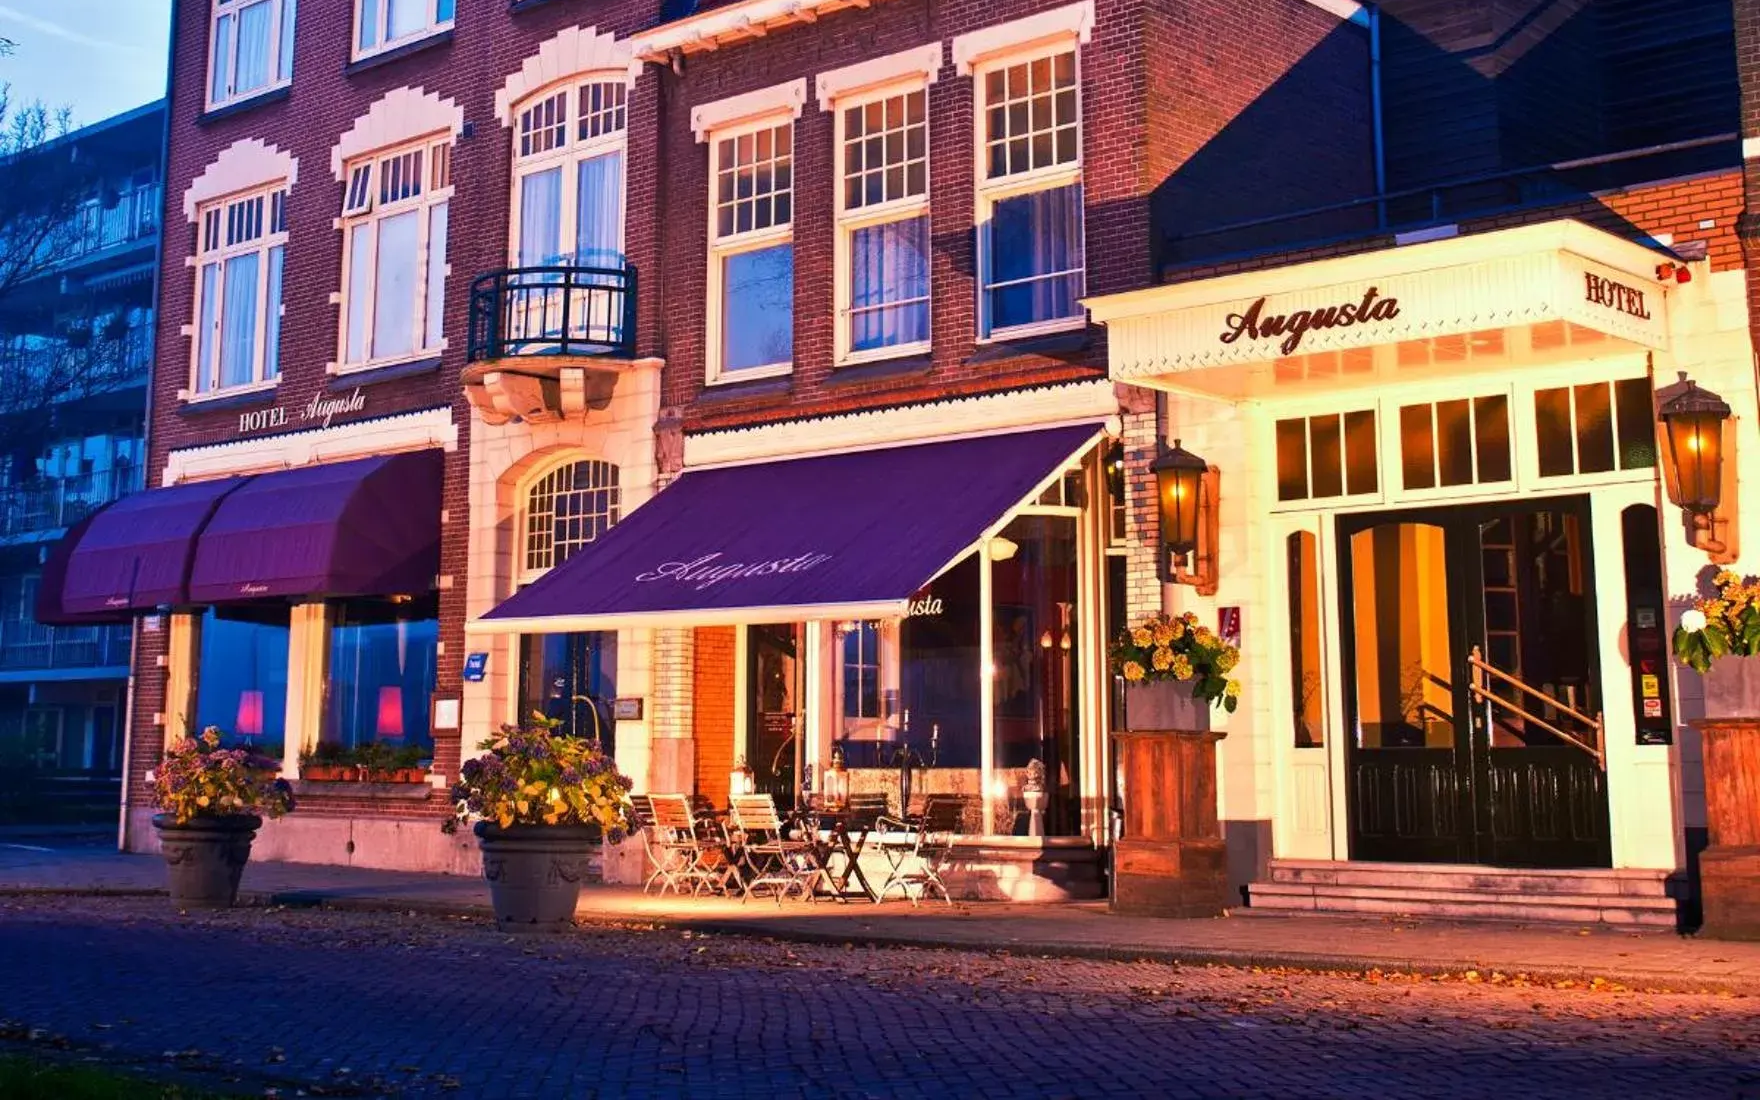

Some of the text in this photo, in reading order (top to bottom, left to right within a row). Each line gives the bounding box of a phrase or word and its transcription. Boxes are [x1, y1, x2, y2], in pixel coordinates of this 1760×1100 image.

[1584, 271, 1651, 320] HOTEL
[1219, 286, 1400, 355] Augusta
[239, 387, 366, 432] HOTEL Augusta
[635, 552, 833, 590] Augusta
